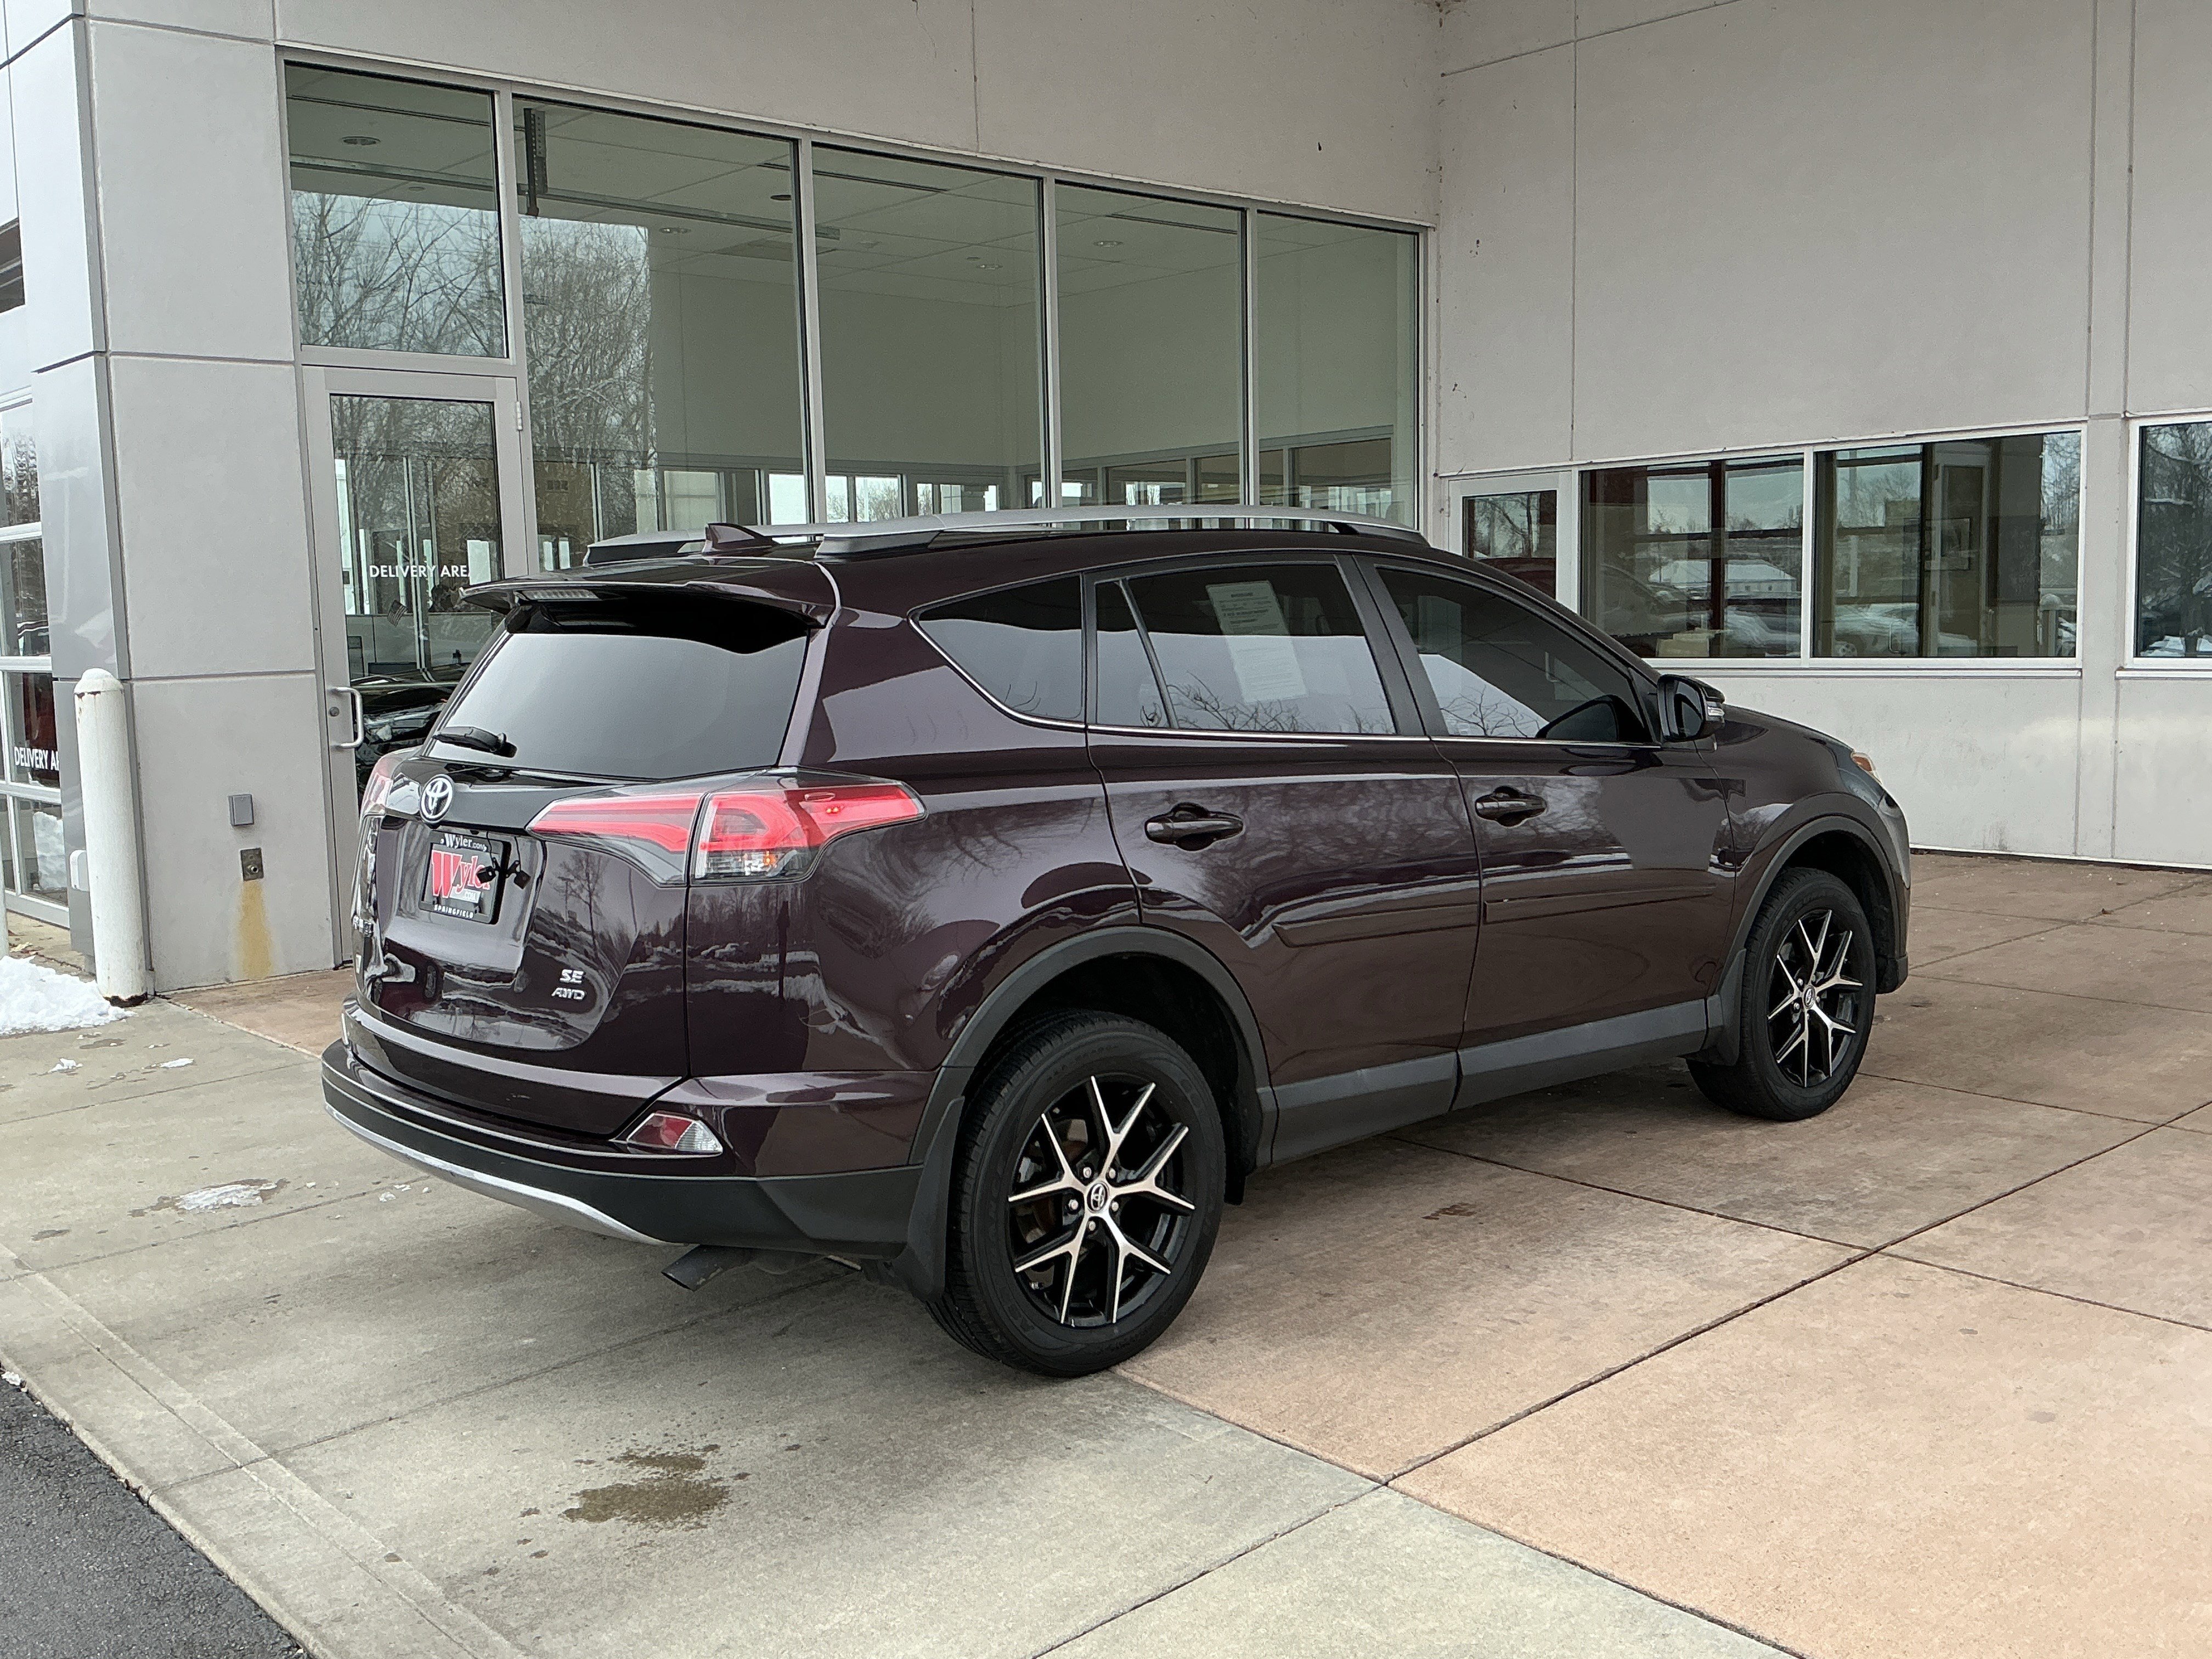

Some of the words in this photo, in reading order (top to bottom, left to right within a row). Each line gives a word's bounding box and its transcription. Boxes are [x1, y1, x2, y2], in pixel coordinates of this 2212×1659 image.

[369, 565, 436, 578] DELIVERY
[441, 565, 470, 578] ARE
[14, 746, 48, 769] DELIVERY
[434, 904, 474, 919] SPRINGFIELD
[560, 969, 584, 984] SE
[551, 987, 585, 1000] AWD
